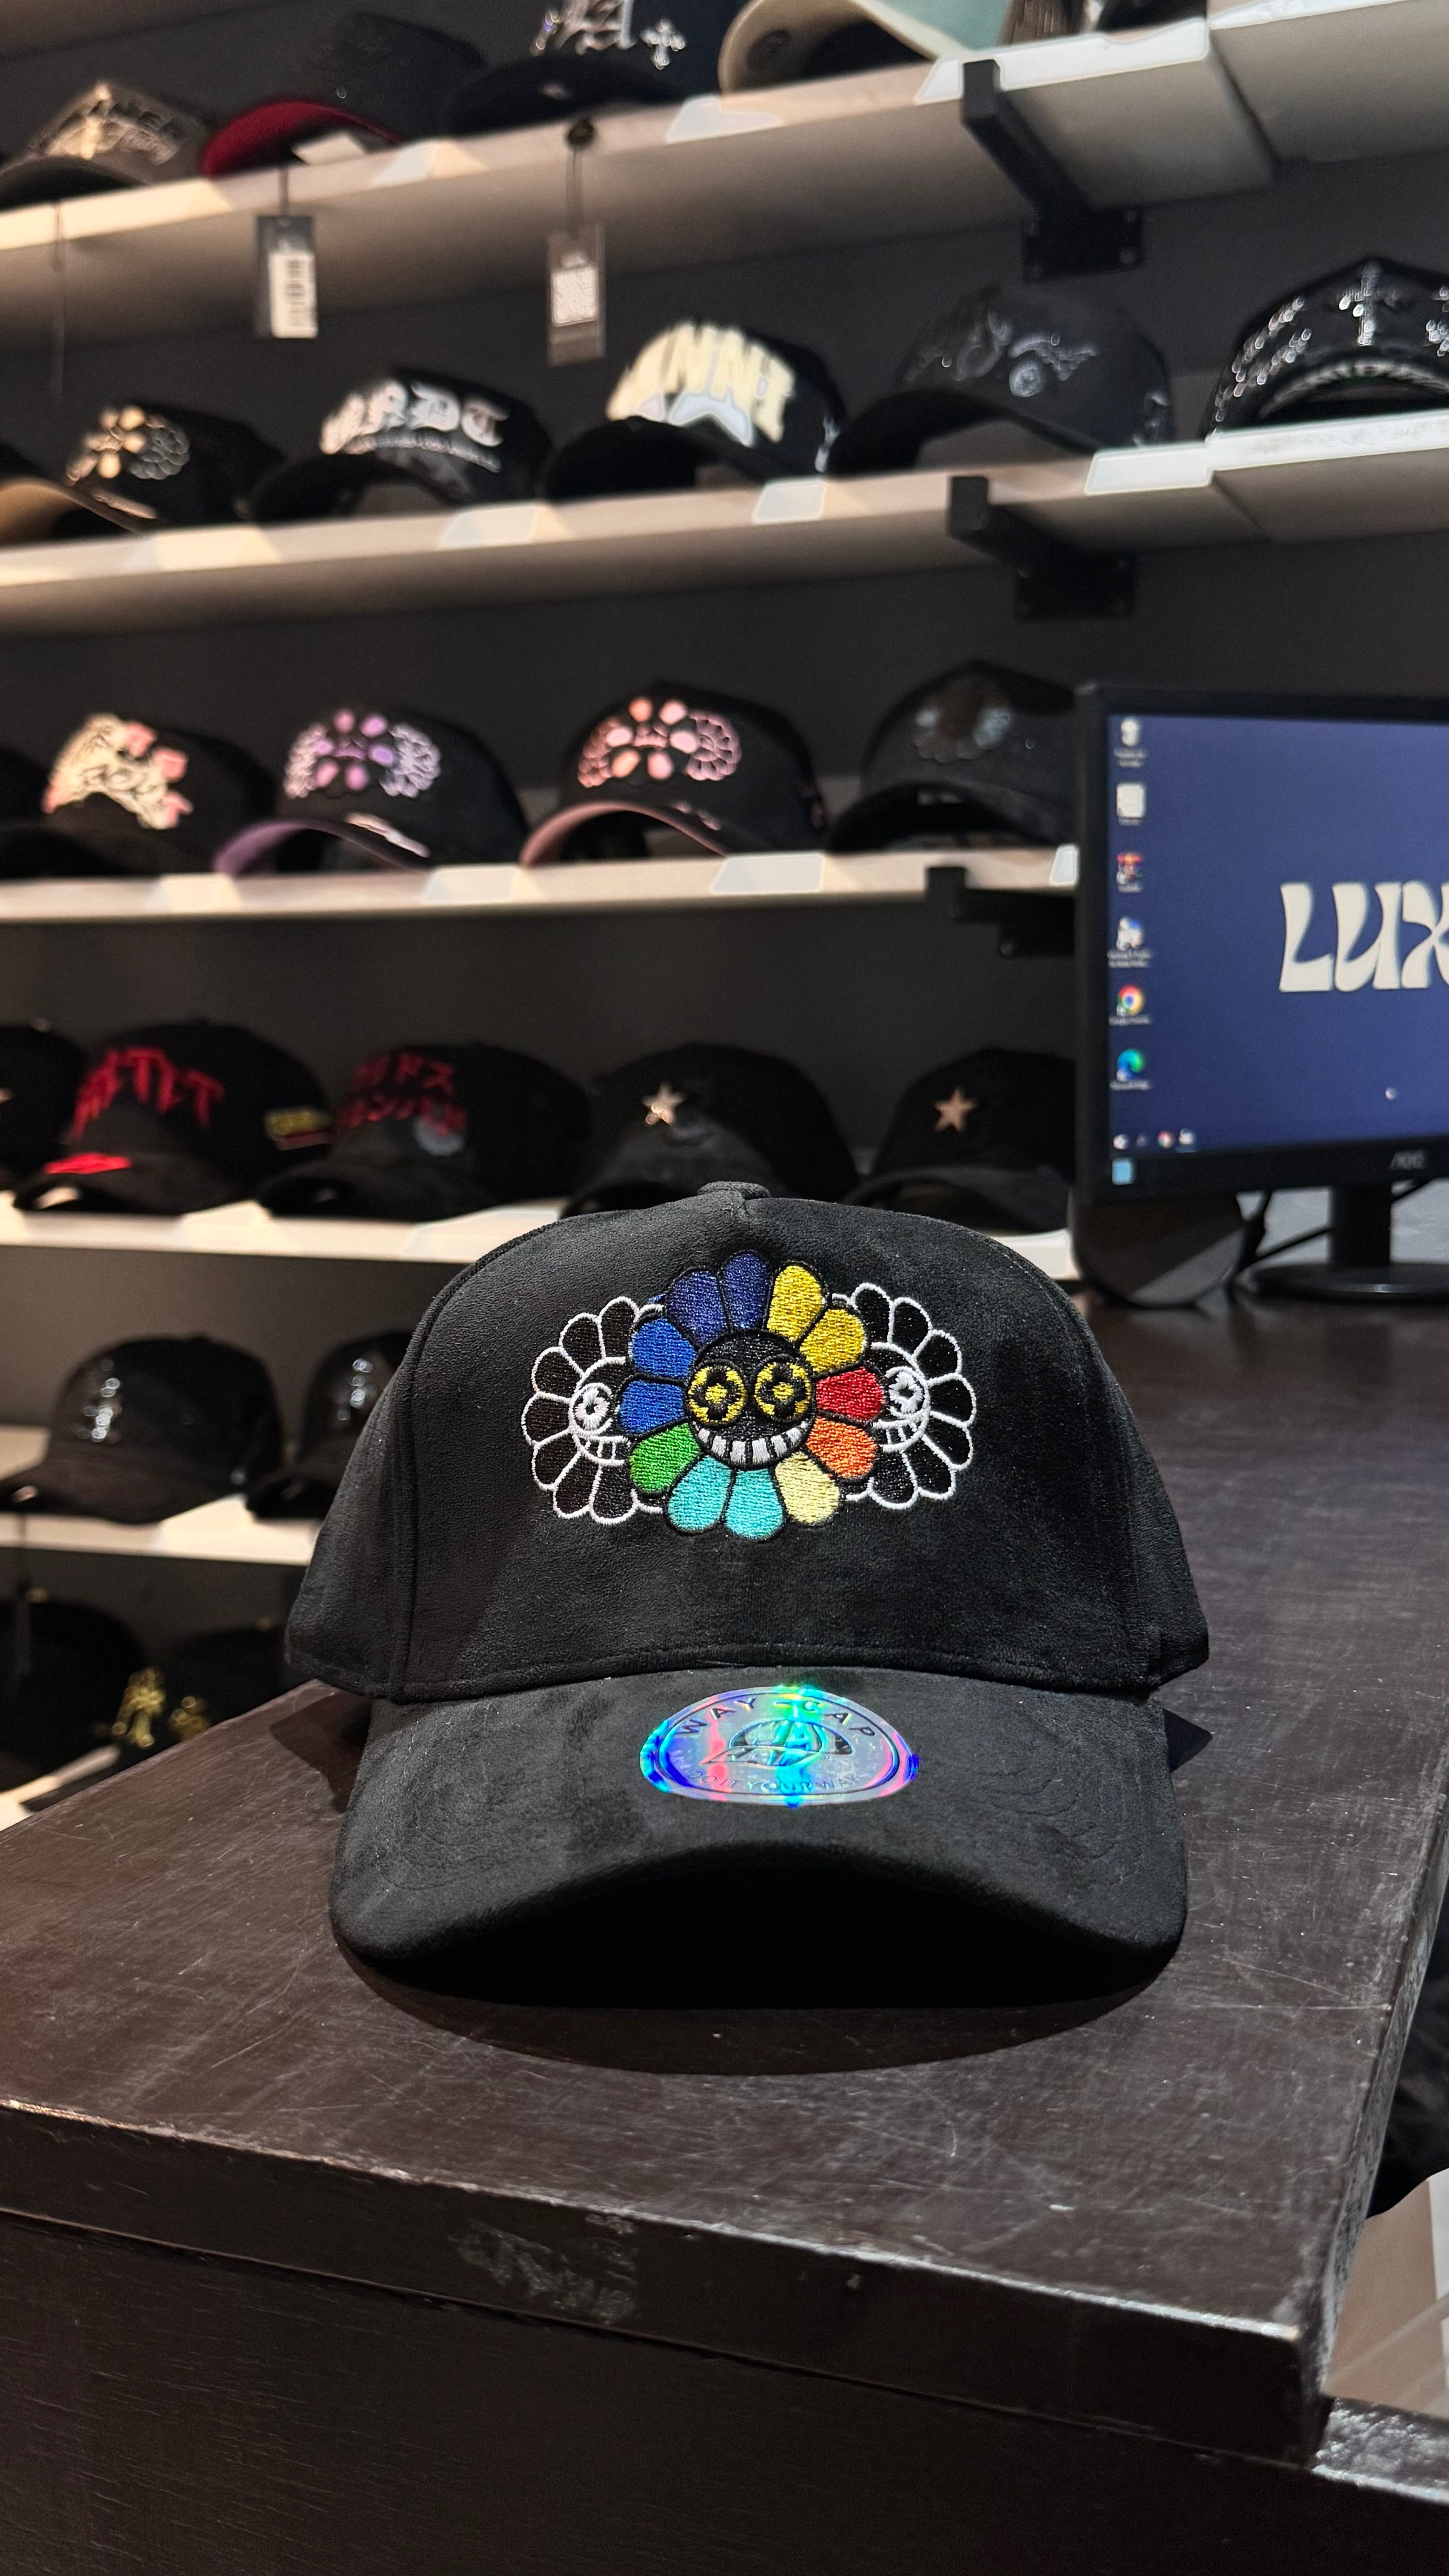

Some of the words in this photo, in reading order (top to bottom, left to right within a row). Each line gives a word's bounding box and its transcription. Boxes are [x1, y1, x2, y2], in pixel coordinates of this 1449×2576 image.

[1278, 880, 1449, 993] LUX
[676, 1696, 756, 1735] WAY
[802, 1699, 876, 1736] CAP
